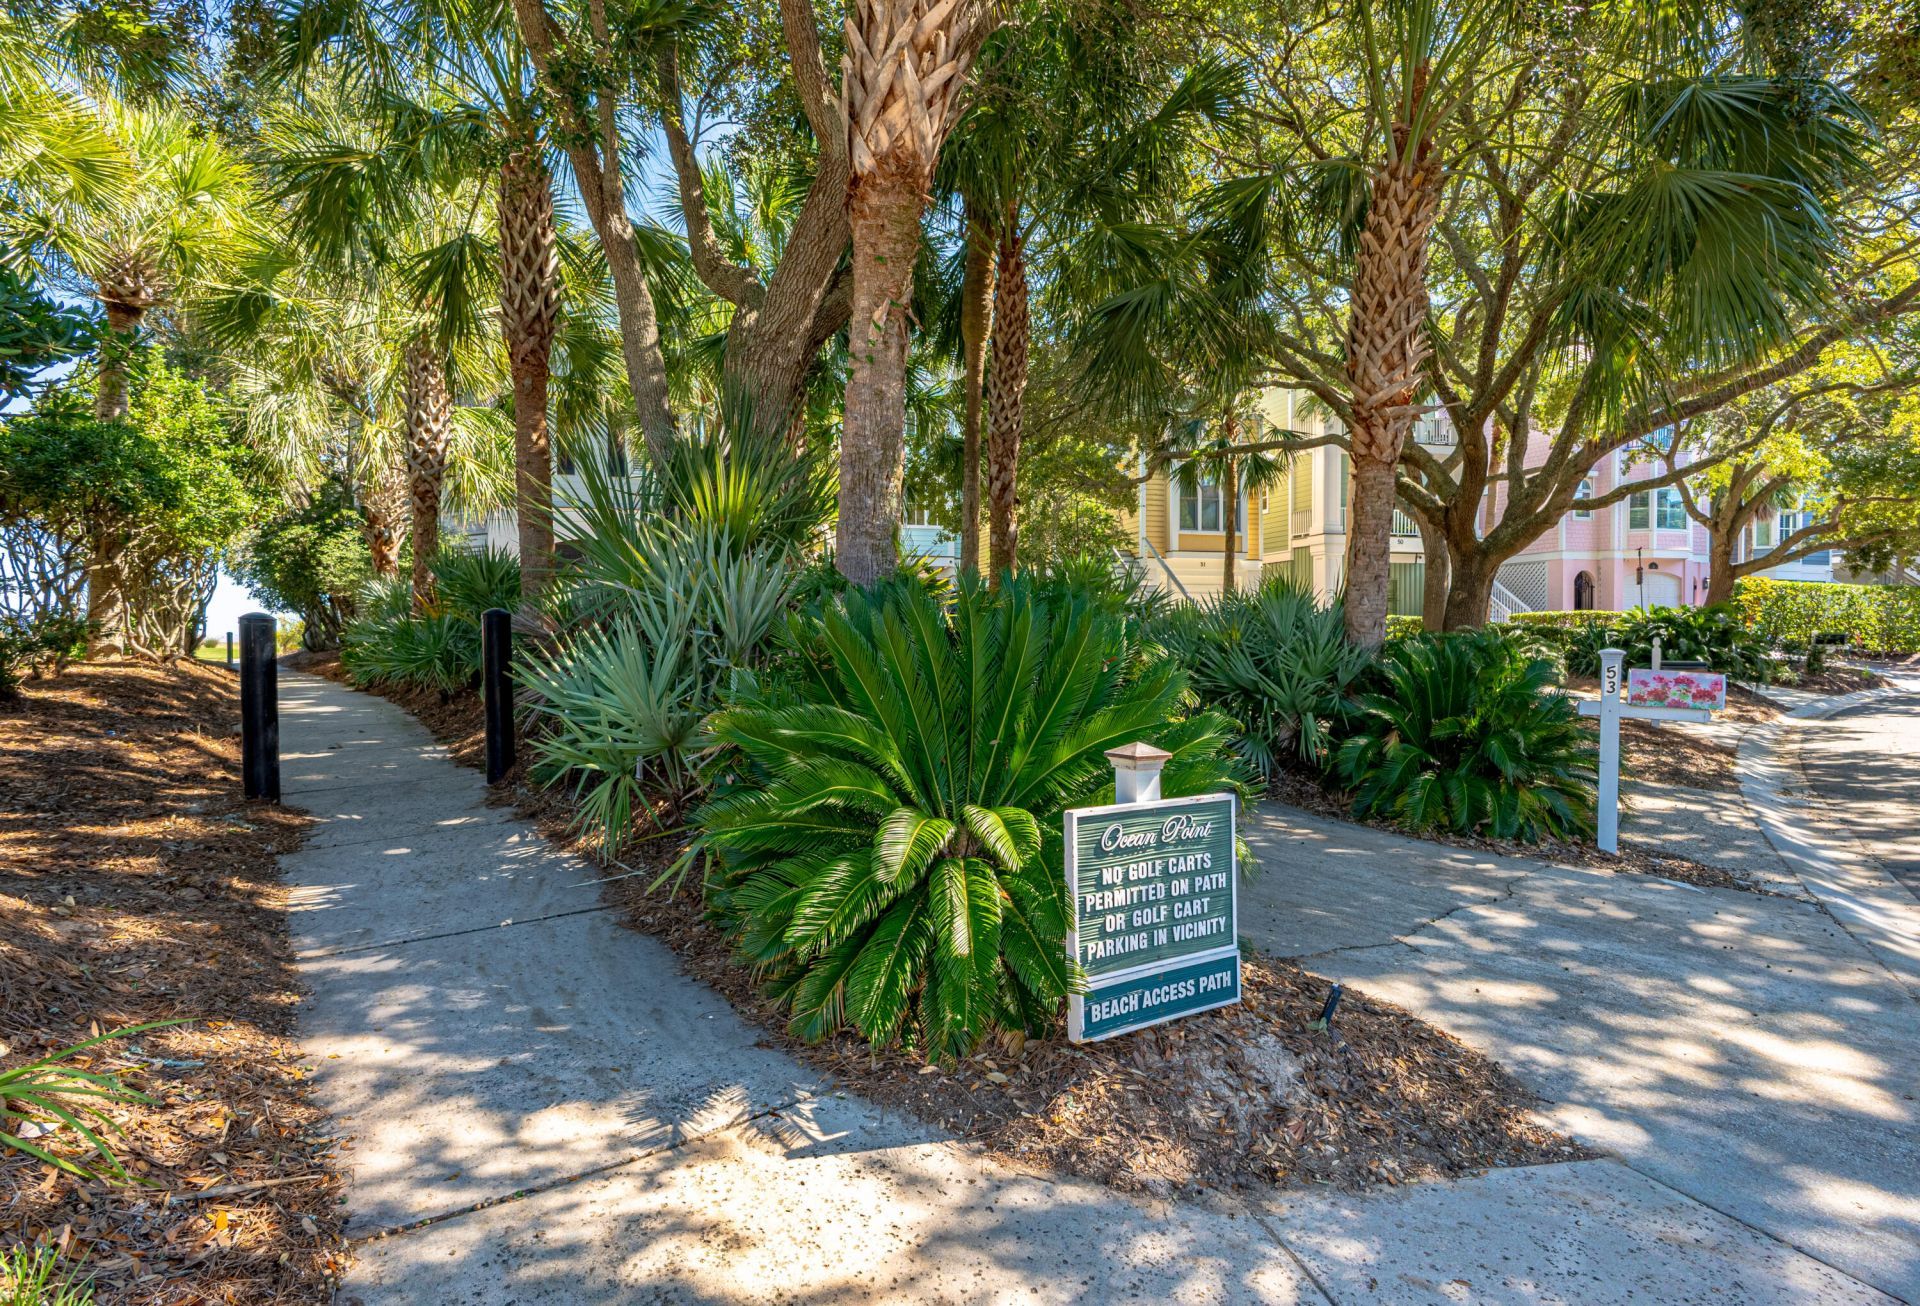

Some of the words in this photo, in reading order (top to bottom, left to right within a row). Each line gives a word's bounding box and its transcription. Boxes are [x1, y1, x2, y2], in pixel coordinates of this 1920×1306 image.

[1101, 823, 1157, 851] Ocean
[1162, 815, 1212, 842] Point
[1102, 867, 1123, 885] NO
[1129, 860, 1162, 879] GOLF
[1168, 853, 1212, 873] CARTS
[1086, 883, 1165, 912] PERMITTED
[1171, 878, 1189, 896] ON
[1195, 872, 1226, 890] PATH
[1105, 914, 1125, 932] OR
[1132, 906, 1168, 927] GOLF
[1174, 898, 1210, 918] CART
[1087, 932, 1148, 961] PARKING
[1153, 928, 1167, 946] IN
[1173, 917, 1227, 941] VICINITY
[1091, 993, 1139, 1022] BEACH
[1142, 979, 1195, 1008] ACCESS
[1200, 971, 1231, 994] PATH
